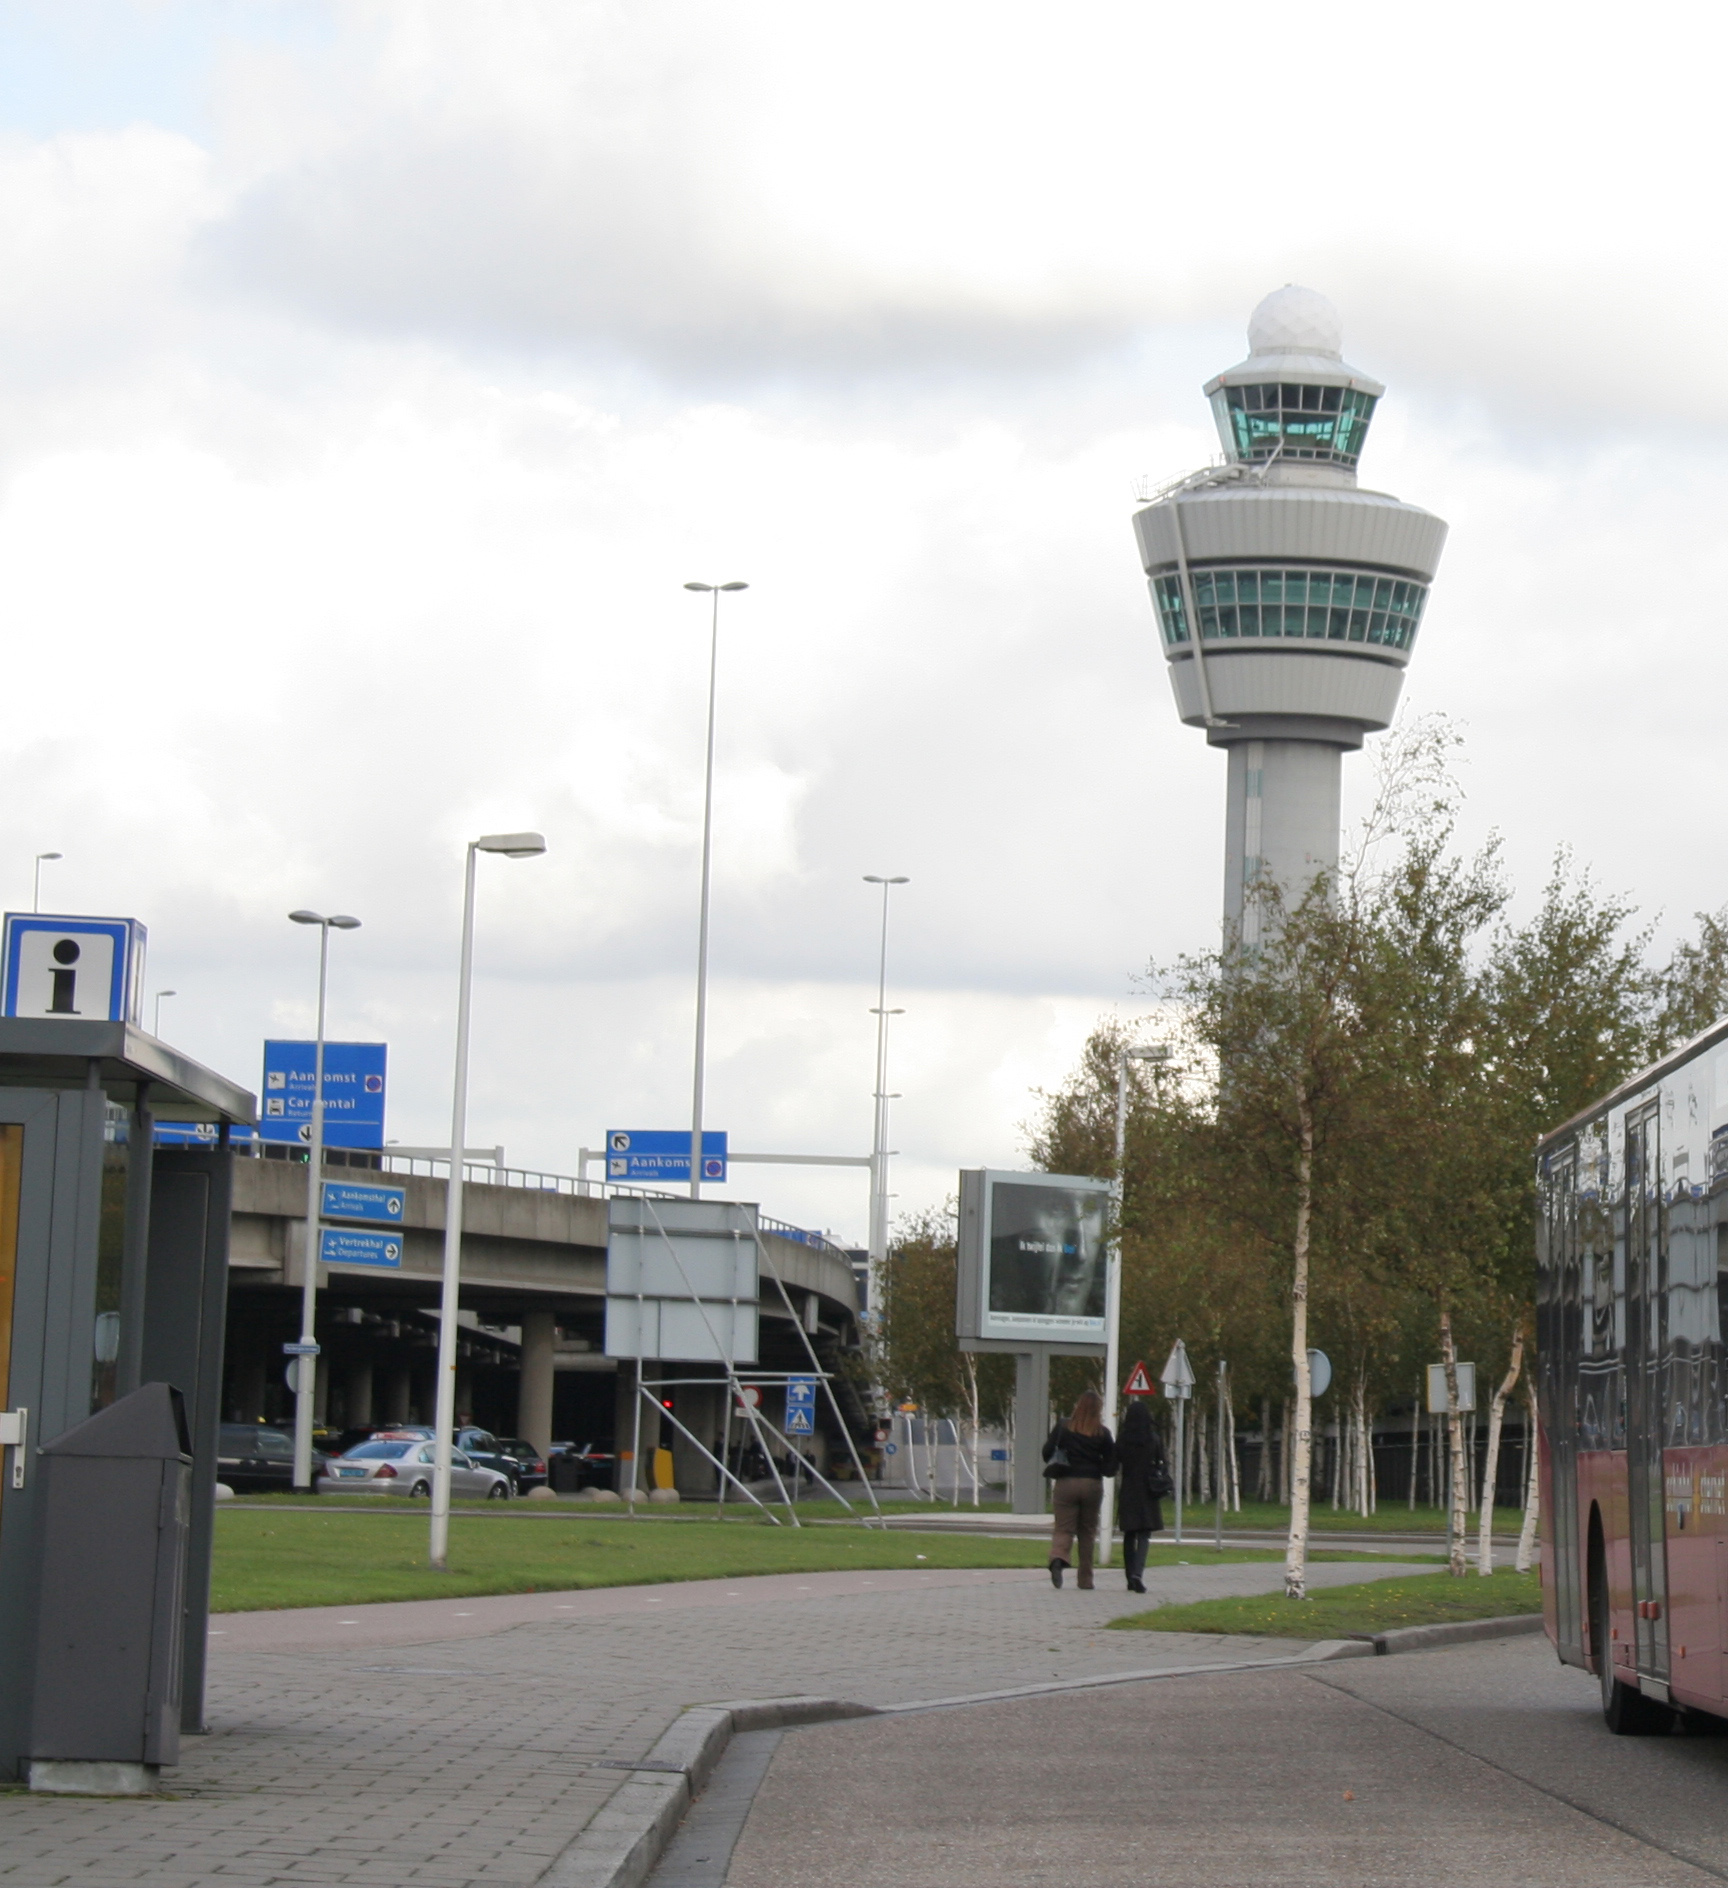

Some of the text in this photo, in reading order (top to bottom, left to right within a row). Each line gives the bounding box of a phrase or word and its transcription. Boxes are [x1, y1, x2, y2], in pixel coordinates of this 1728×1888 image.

[289, 1070, 357, 1083] Aanomst
[288, 1097, 356, 1109] Car ental
[631, 1157, 692, 1168] Aankoms
[339, 1237, 384, 1249] Vertrekhal
